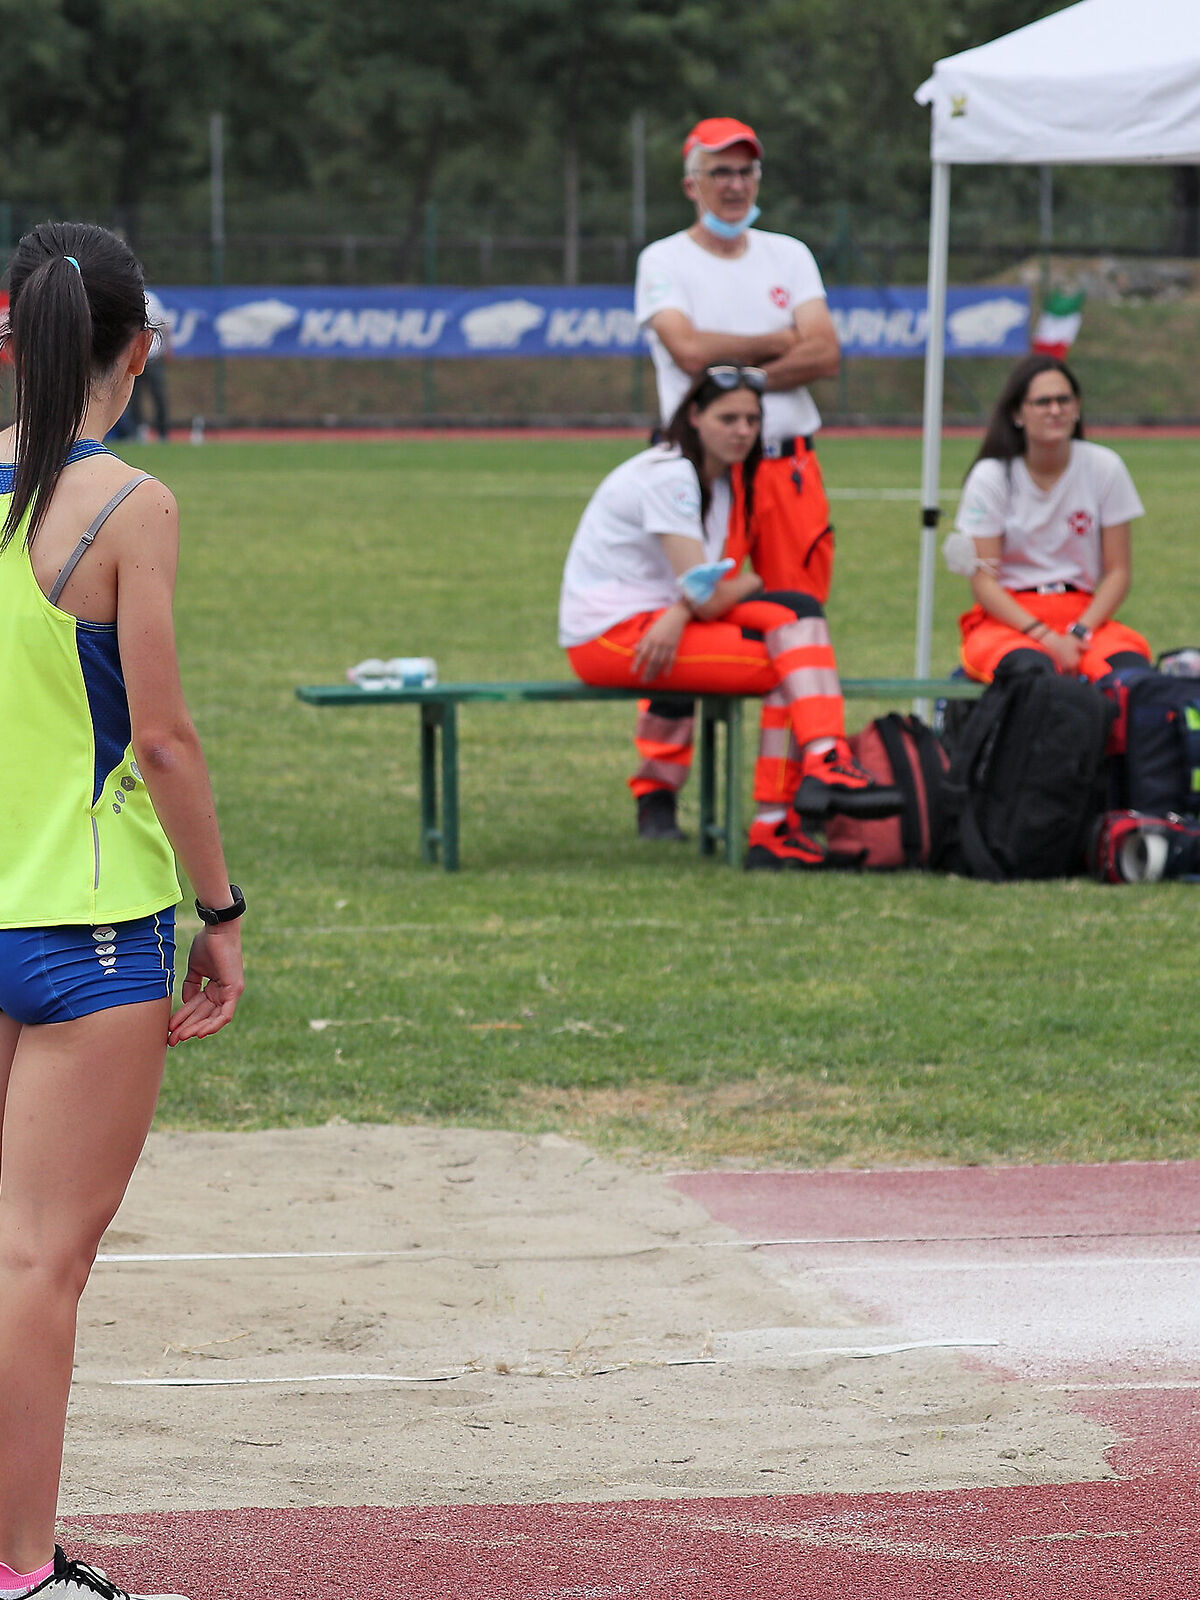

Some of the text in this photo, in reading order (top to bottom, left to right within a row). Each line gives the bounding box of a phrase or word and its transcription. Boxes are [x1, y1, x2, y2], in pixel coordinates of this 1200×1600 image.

[300, 308, 446, 348] KARHU
[546, 308, 641, 347] KAR
[830, 308, 928, 347] ARHU
